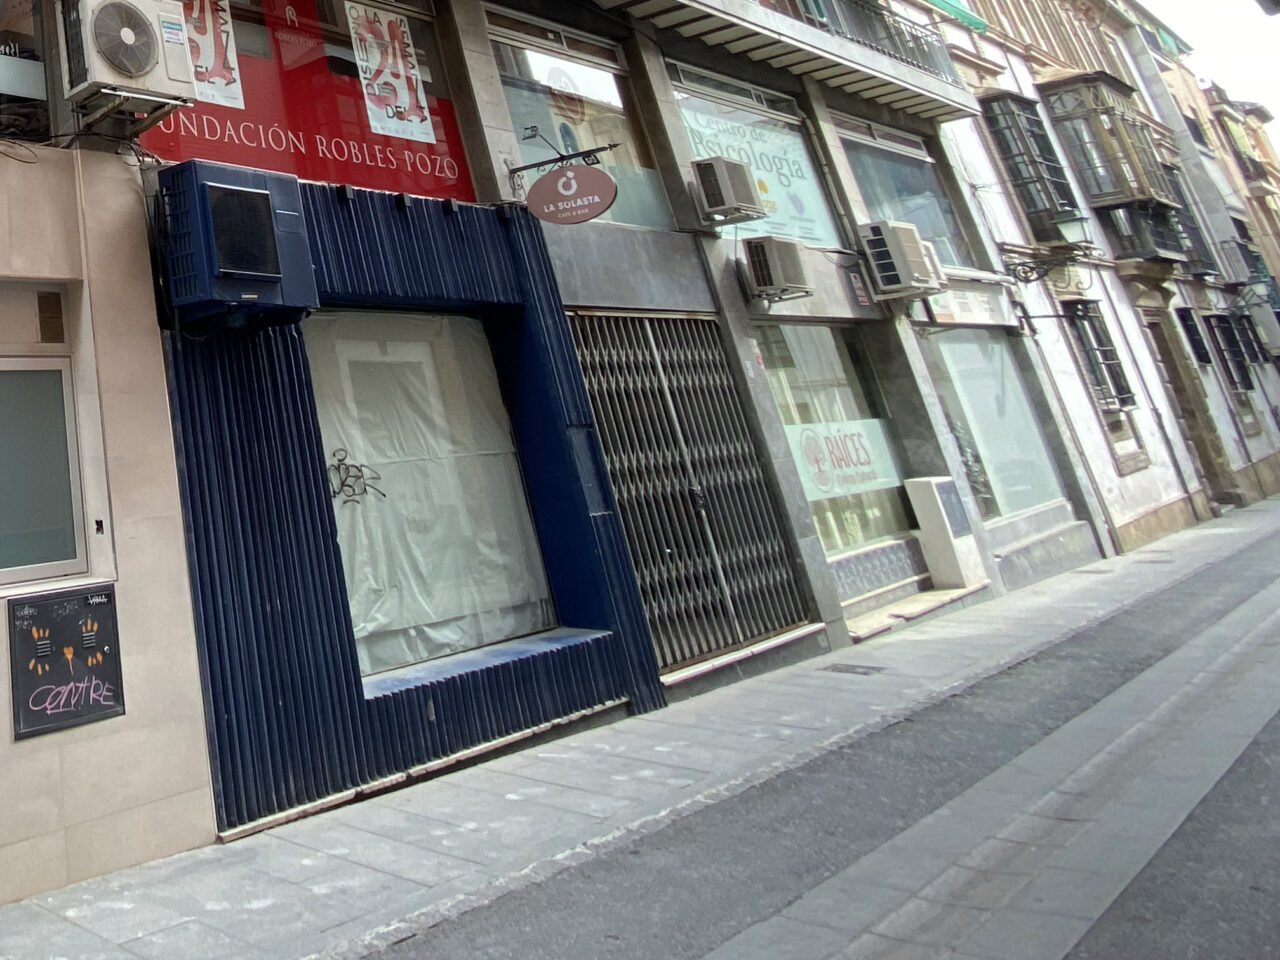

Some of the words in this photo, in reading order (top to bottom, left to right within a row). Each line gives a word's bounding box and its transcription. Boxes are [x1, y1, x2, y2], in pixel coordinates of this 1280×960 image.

[694, 111, 747, 139] Centro
[749, 126, 768, 143] de
[156, 111, 307, 155] UNDACIÓN
[314, 134, 398, 170] ROBLES
[403, 149, 459, 180] POZO
[543, 203, 556, 213] LA
[557, 194, 601, 210] SOLASTA
